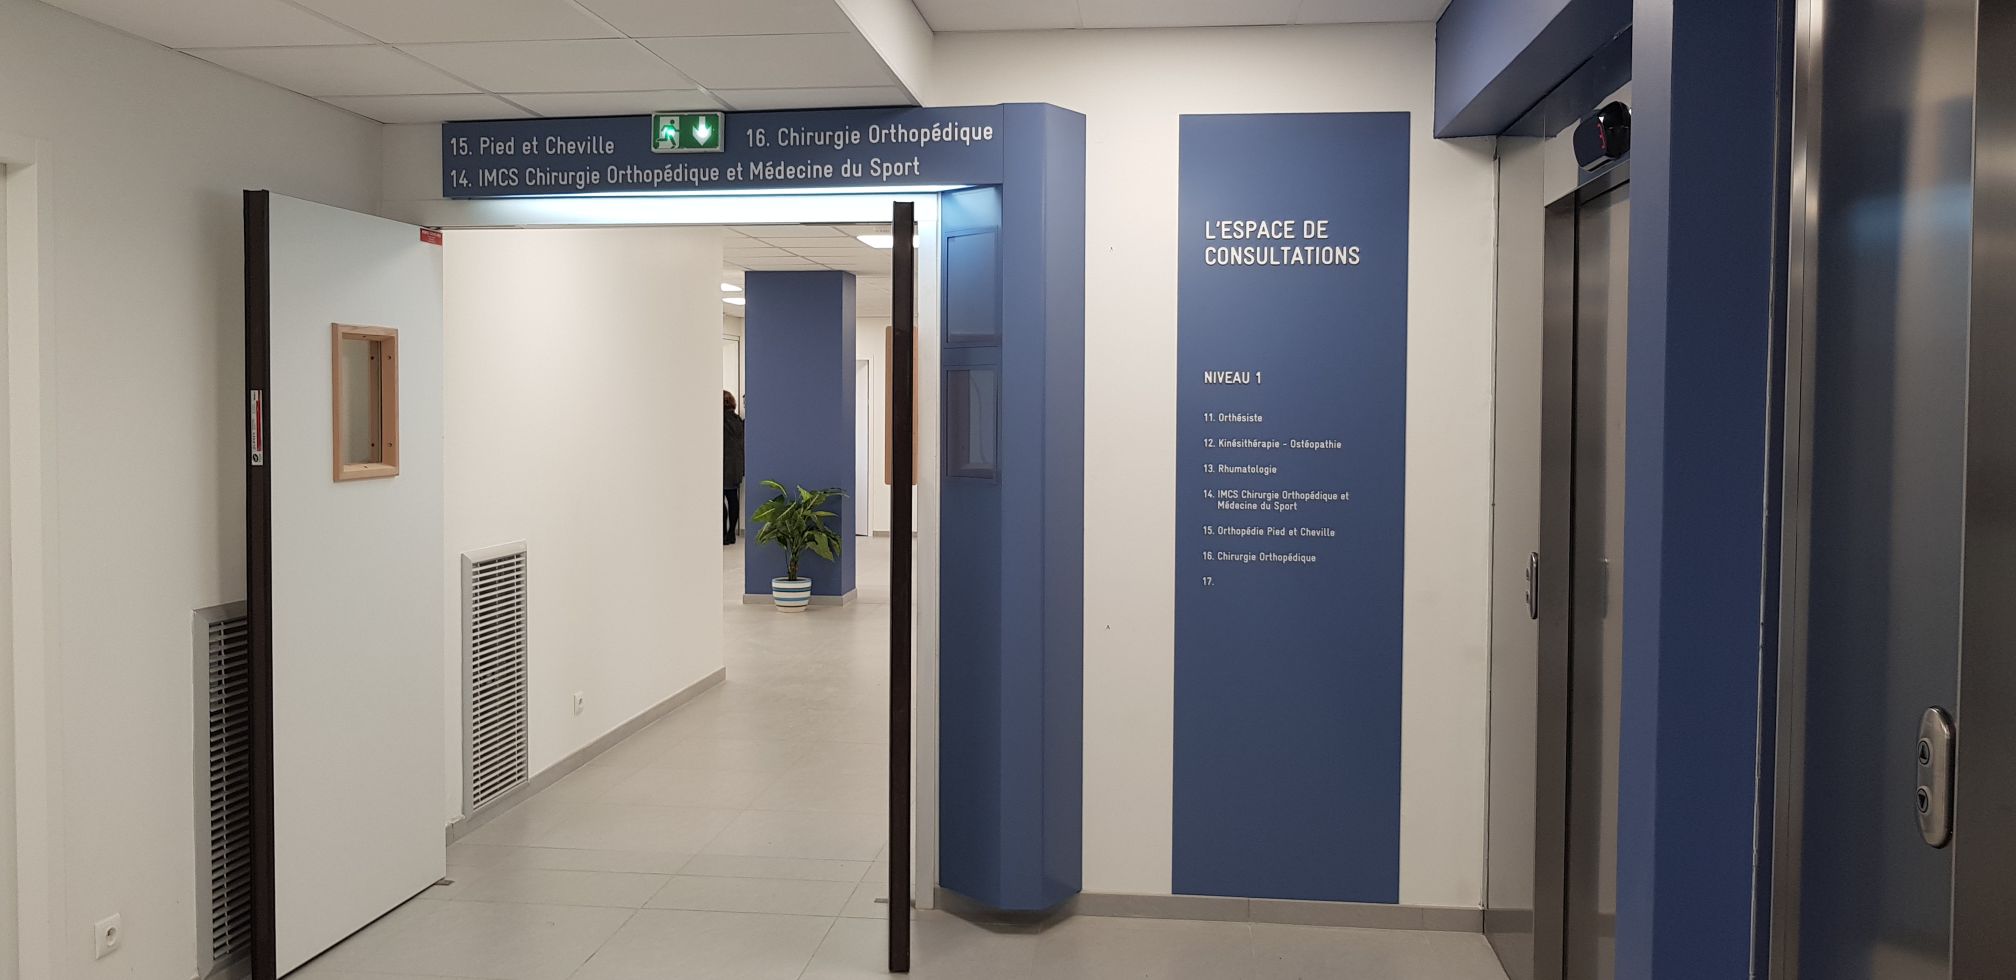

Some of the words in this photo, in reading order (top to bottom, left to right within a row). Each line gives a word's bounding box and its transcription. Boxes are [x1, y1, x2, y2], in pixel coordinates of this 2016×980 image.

[746, 128, 771, 147] 16.
[777, 126, 861, 151] Chirurgie
[868, 121, 994, 148] Orthopédique
[449, 137, 474, 156] 15.
[479, 136, 517, 155] Pied
[522, 137, 539, 155] et
[545, 135, 615, 155] Cheville
[449, 168, 472, 188] 14.
[478, 167, 519, 187] IMCS
[525, 166, 601, 190] Chirurgie
[607, 163, 720, 188] Orthopédique
[726, 163, 744, 180] et
[749, 160, 834, 180] Médecine
[840, 158, 862, 178] du
[869, 157, 921, 181] Sport
[1205, 220, 1295, 239] L'ESPACE
[1303, 220, 1329, 239] DE
[1205, 246, 1360, 265] CONSULTATIONS
[1204, 371, 1250, 384] NIVEAU
[1256, 372, 1261, 384] 1
[1204, 413, 1215, 422] 11.
[1218, 413, 1263, 422] Orthésiste
[1204, 439, 1215, 448] 12.
[1218, 439, 1280, 450] Kinésithérapie
[1290, 440, 1342, 450] Ostéopathie
[1204, 464, 1215, 473] 13.
[1218, 464, 1277, 475] Rhumatologie
[1204, 490, 1214, 498] 14.
[1217, 490, 1238, 498] IMCS
[1241, 490, 1279, 500] Chirurgie
[1282, 490, 1338, 501] Orthopédique
[1340, 492, 1349, 500] et
[1217, 501, 1257, 510] Médecine
[1260, 502, 1271, 510] du
[1274, 502, 1297, 512] Sport
[1203, 526, 1215, 535] 15.
[1218, 526, 1263, 537] Orthopédie
[1267, 527, 1285, 536] Pied
[1289, 527, 1297, 536] et
[1301, 527, 1335, 537] Cheville
[1203, 552, 1214, 561] 16.
[1217, 552, 1256, 563] Chirurgie
[1259, 552, 1316, 564] Orthopédique
[1203, 577, 1214, 586] 17.
